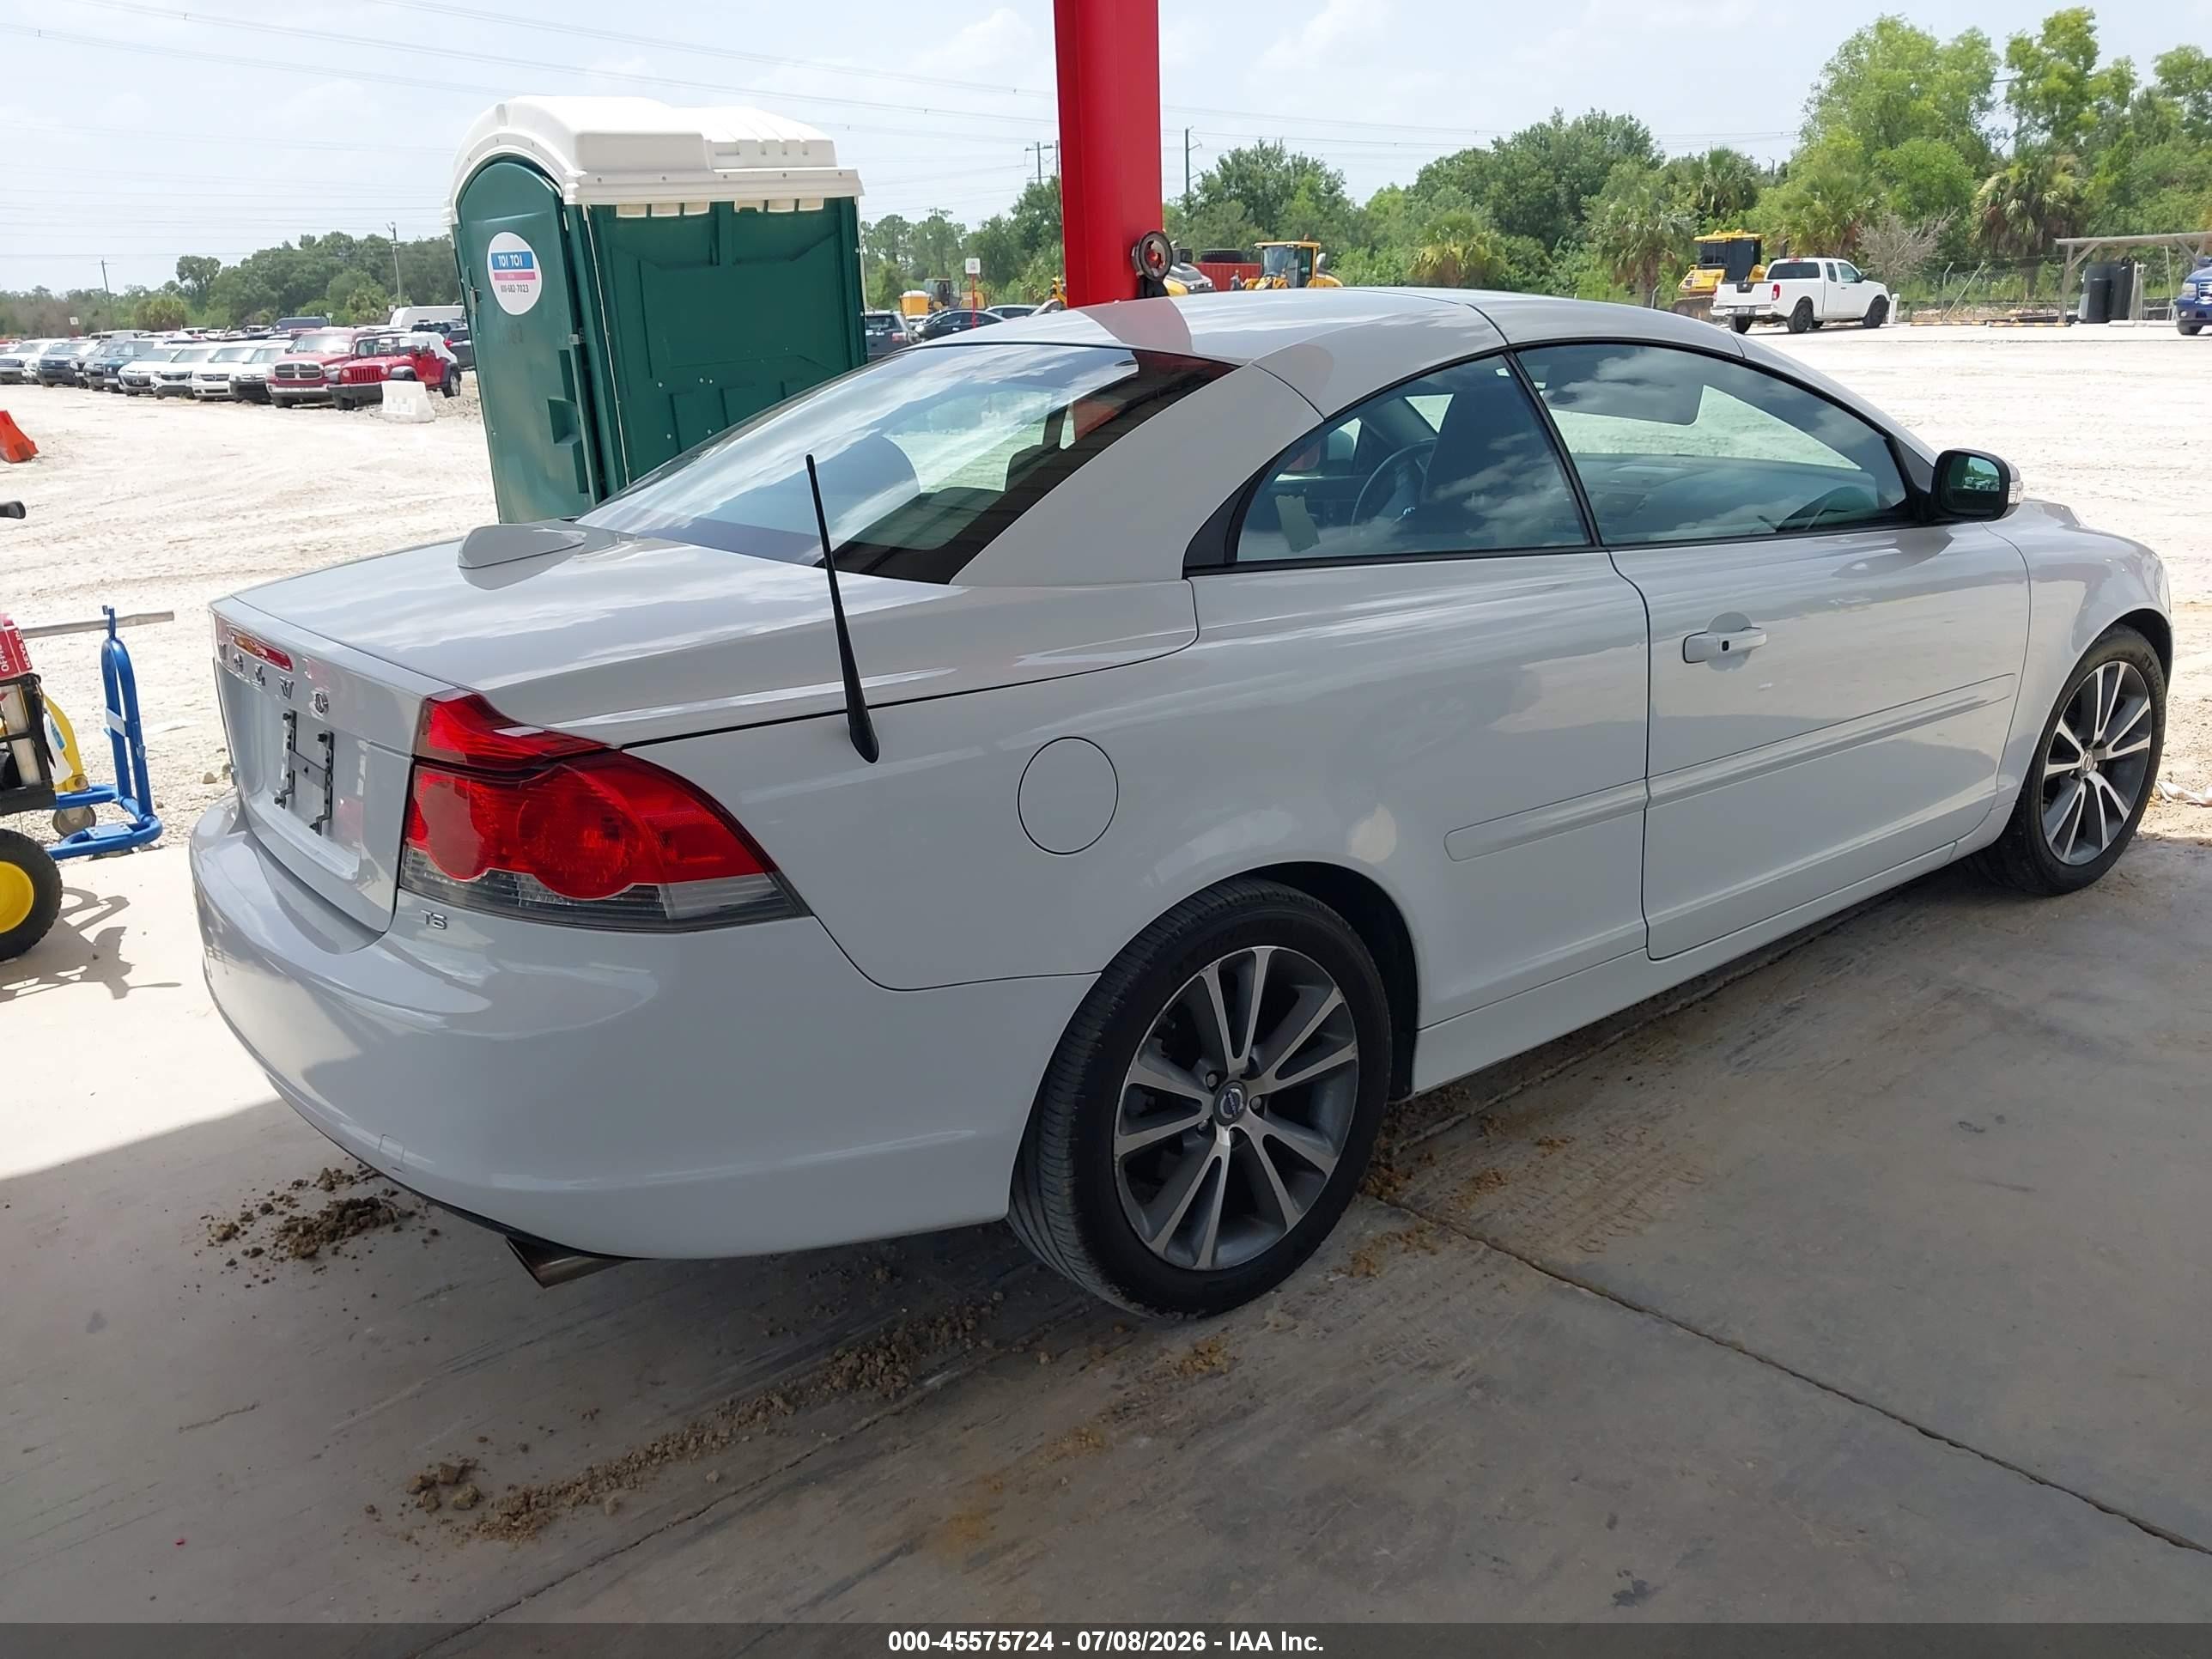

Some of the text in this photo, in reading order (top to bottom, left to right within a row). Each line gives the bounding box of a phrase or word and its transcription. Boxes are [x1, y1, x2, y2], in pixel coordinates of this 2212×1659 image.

[498, 254, 523, 267] TOI TOI
[501, 284, 530, 293] -682-7023
